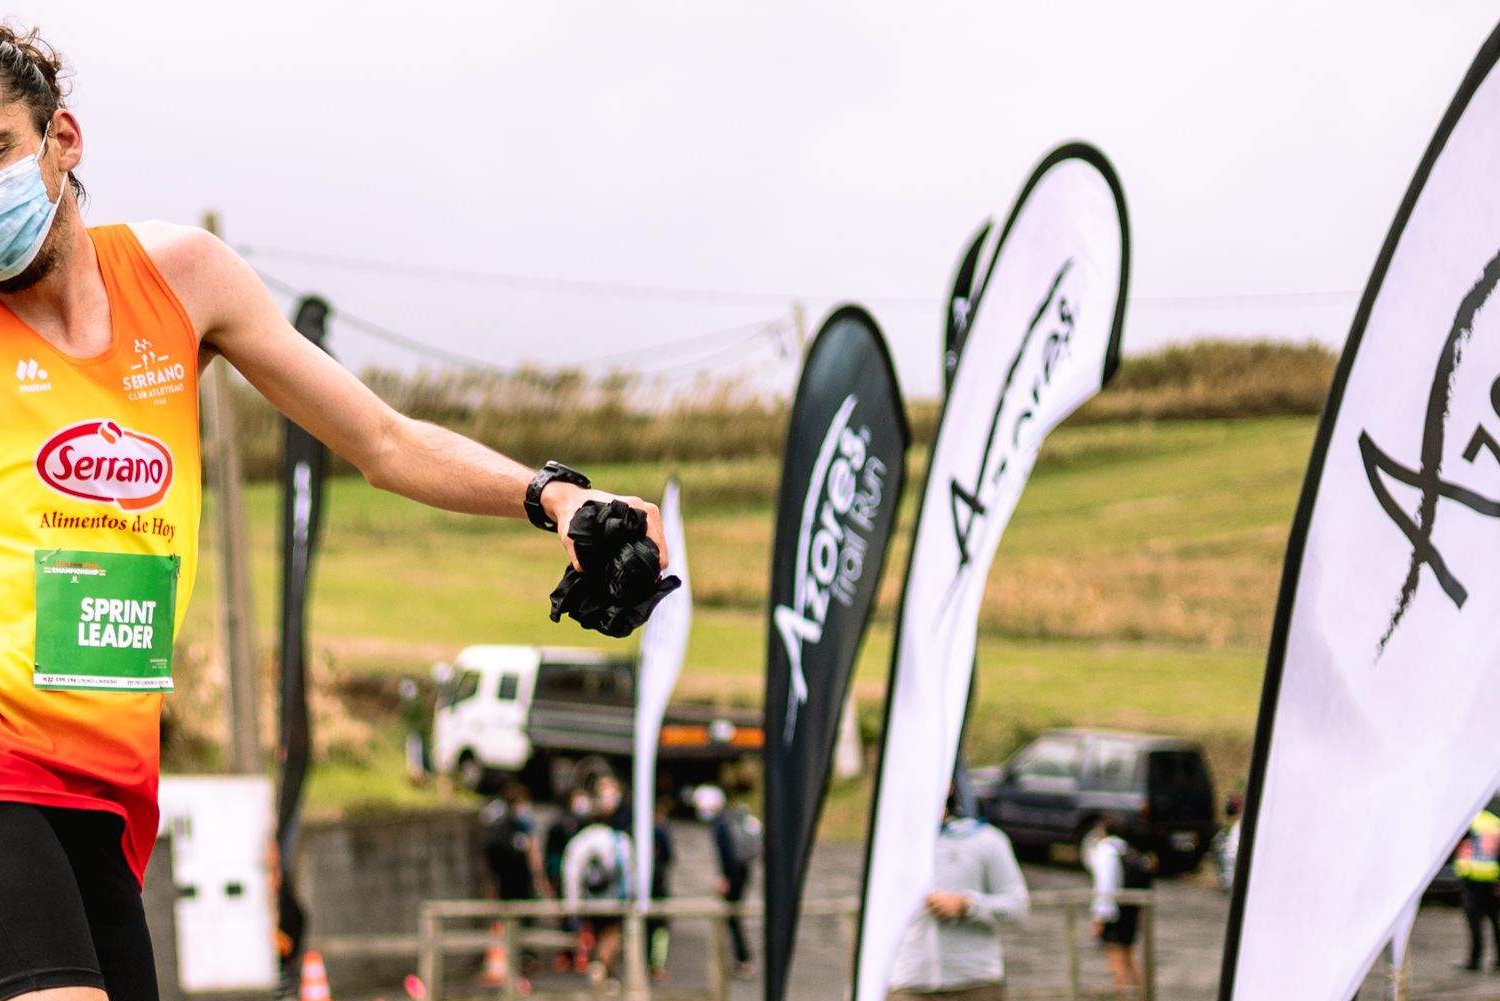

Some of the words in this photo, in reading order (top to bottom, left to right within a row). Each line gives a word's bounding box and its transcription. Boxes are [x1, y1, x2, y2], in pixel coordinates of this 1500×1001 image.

[122, 363, 185, 391] SERRANO
[52, 445, 163, 484] Serrano
[40, 511, 128, 531] Alimentos
[131, 515, 149, 533] de
[151, 517, 176, 543] Hoy
[80, 597, 157, 624] SPRINT
[78, 622, 154, 649] LEADER
